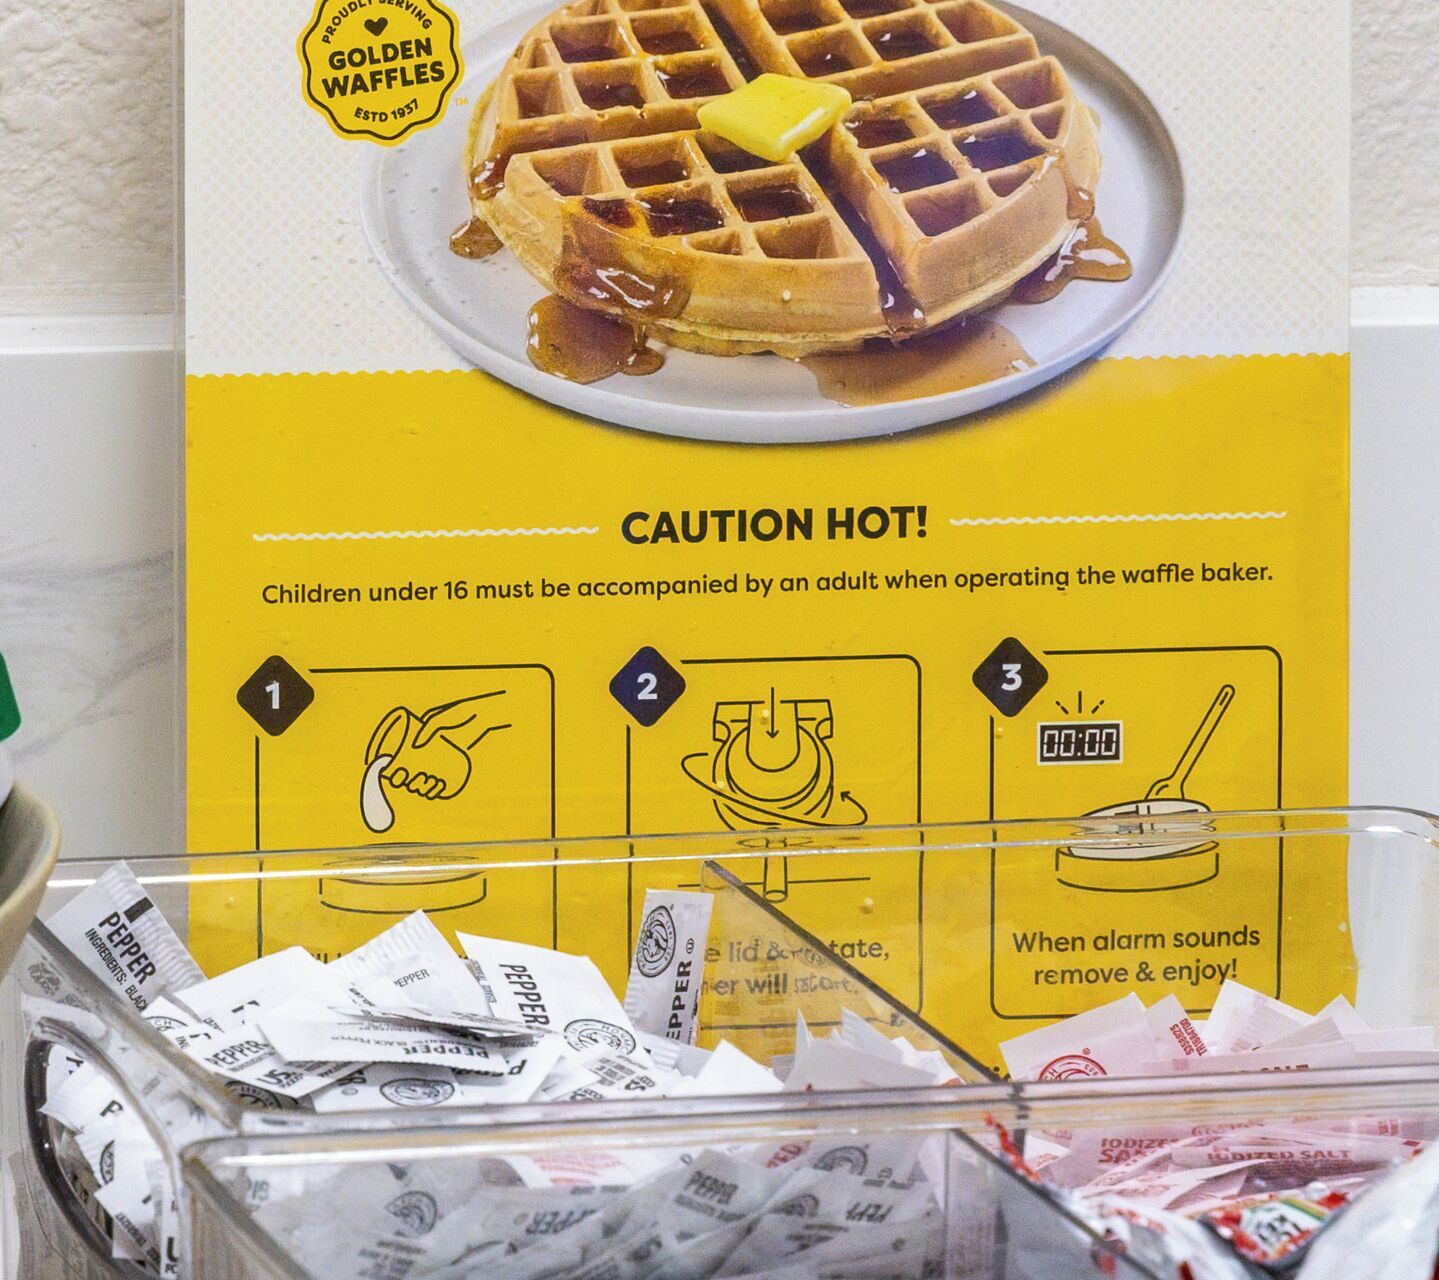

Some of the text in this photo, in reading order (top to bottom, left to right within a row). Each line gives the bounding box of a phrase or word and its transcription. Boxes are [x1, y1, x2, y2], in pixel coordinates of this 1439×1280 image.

[328, 37, 433, 71] GOLDEN
[321, 61, 445, 98] WAFFLES
[354, 98, 419, 122] ESTD 1937
[621, 505, 927, 545] CAUTION HOT!
[262, 561, 1274, 604] Children under 16 must be accompanied by an adult when operating the waffle baker.
[636, 672, 658, 701] 2
[1000, 663, 1023, 692] 3
[264, 680, 281, 710] 1
[1042, 728, 1117, 758] 00:00
[98, 910, 157, 986] PEPPER
[1012, 924, 1261, 953] When alarm sounds
[84, 927, 127, 985] INGREDIENTS:
[745, 972, 789, 995] will
[1034, 957, 1237, 987] remove & enjoy!
[498, 963, 550, 1028] PEPPER
[666, 959, 693, 1042] EPPER
[204, 1038, 270, 1068] PEPPER
[402, 1045, 491, 1060] PEPPER
[1206, 1149, 1352, 1163] IODIZED SALT
